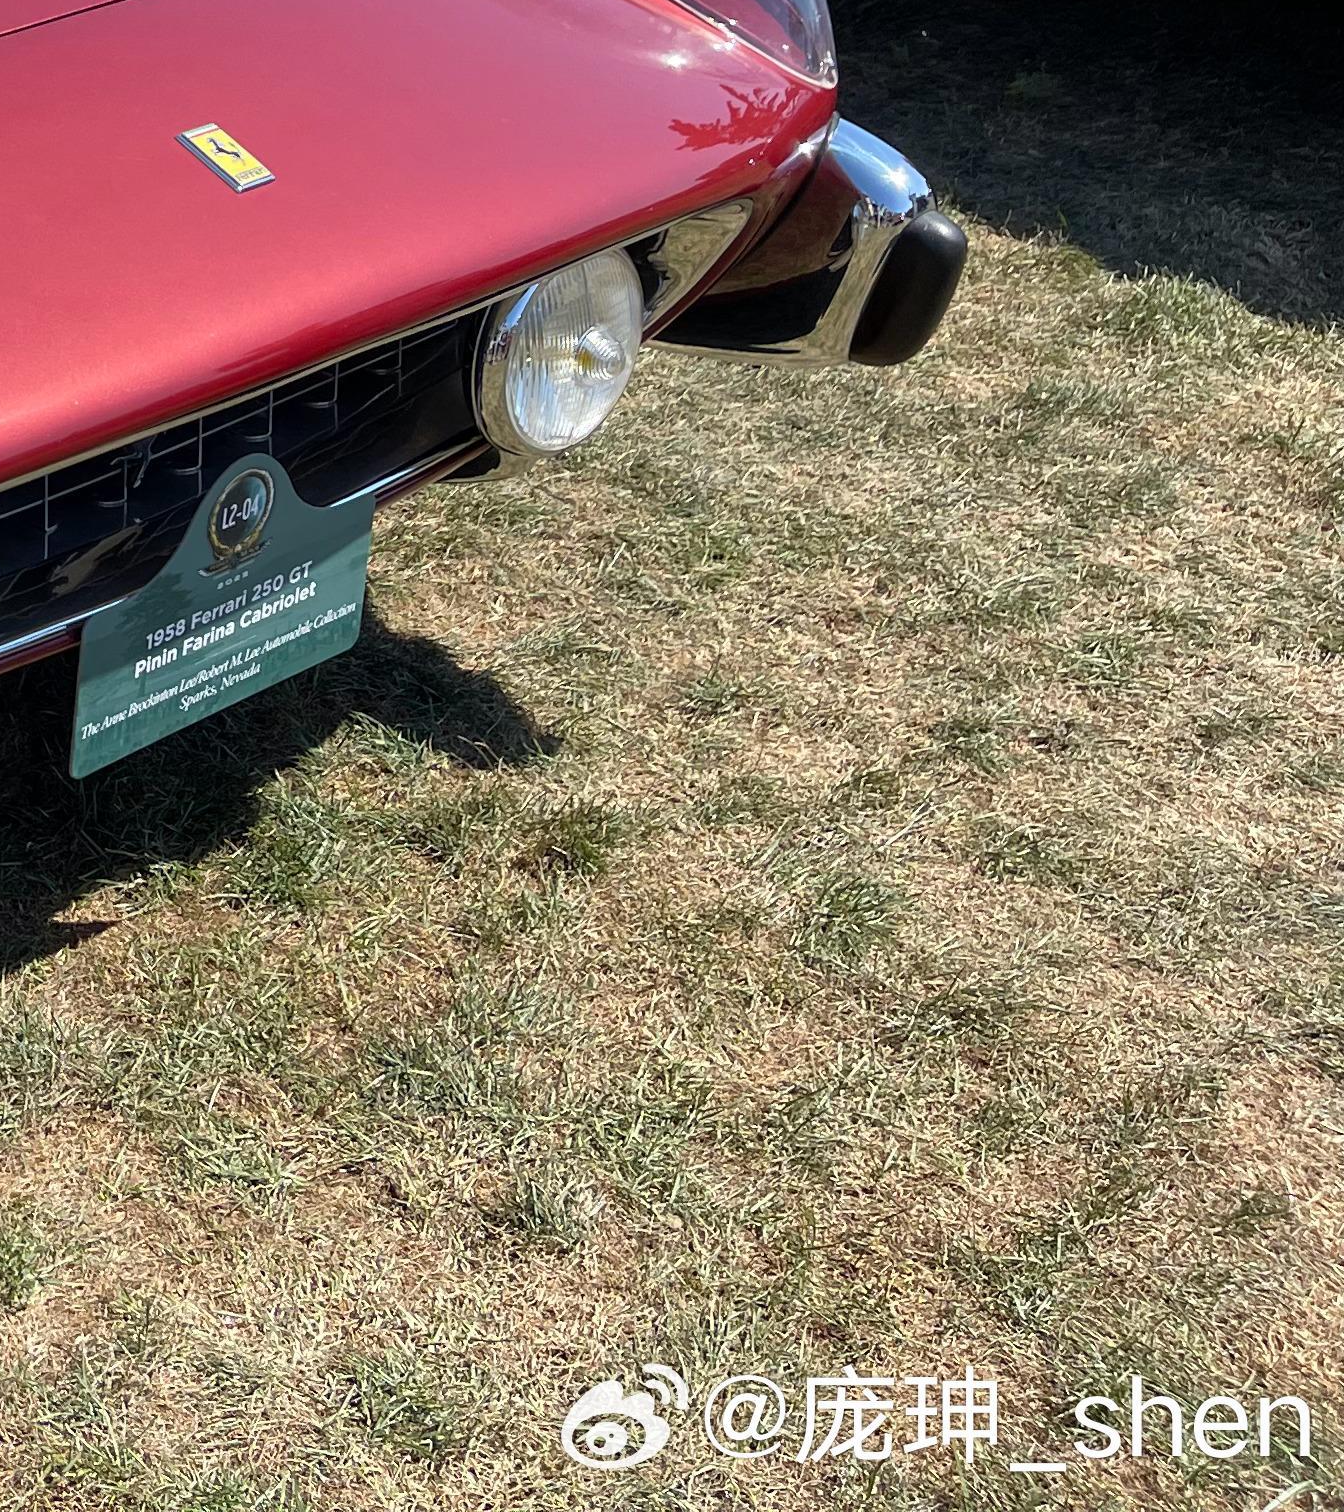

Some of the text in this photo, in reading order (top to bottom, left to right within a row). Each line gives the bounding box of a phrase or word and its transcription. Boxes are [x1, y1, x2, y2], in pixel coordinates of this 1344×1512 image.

[221, 494, 260, 530] L2-04
[134, 581, 317, 678] Pinin Farina Cabriolet
[146, 560, 312, 649] 1958 Ferrari 250 GT
[81, 719, 101, 740] The
[100, 708, 128, 731] Anne
[179, 659, 230, 694] Lee/Robert
[229, 653, 244, 667] M.
[244, 645, 262, 662] Lee
[261, 620, 314, 654] Automobile
[313, 601, 357, 628] Collection
[179, 662, 261, 712] Sparks, Nevada
